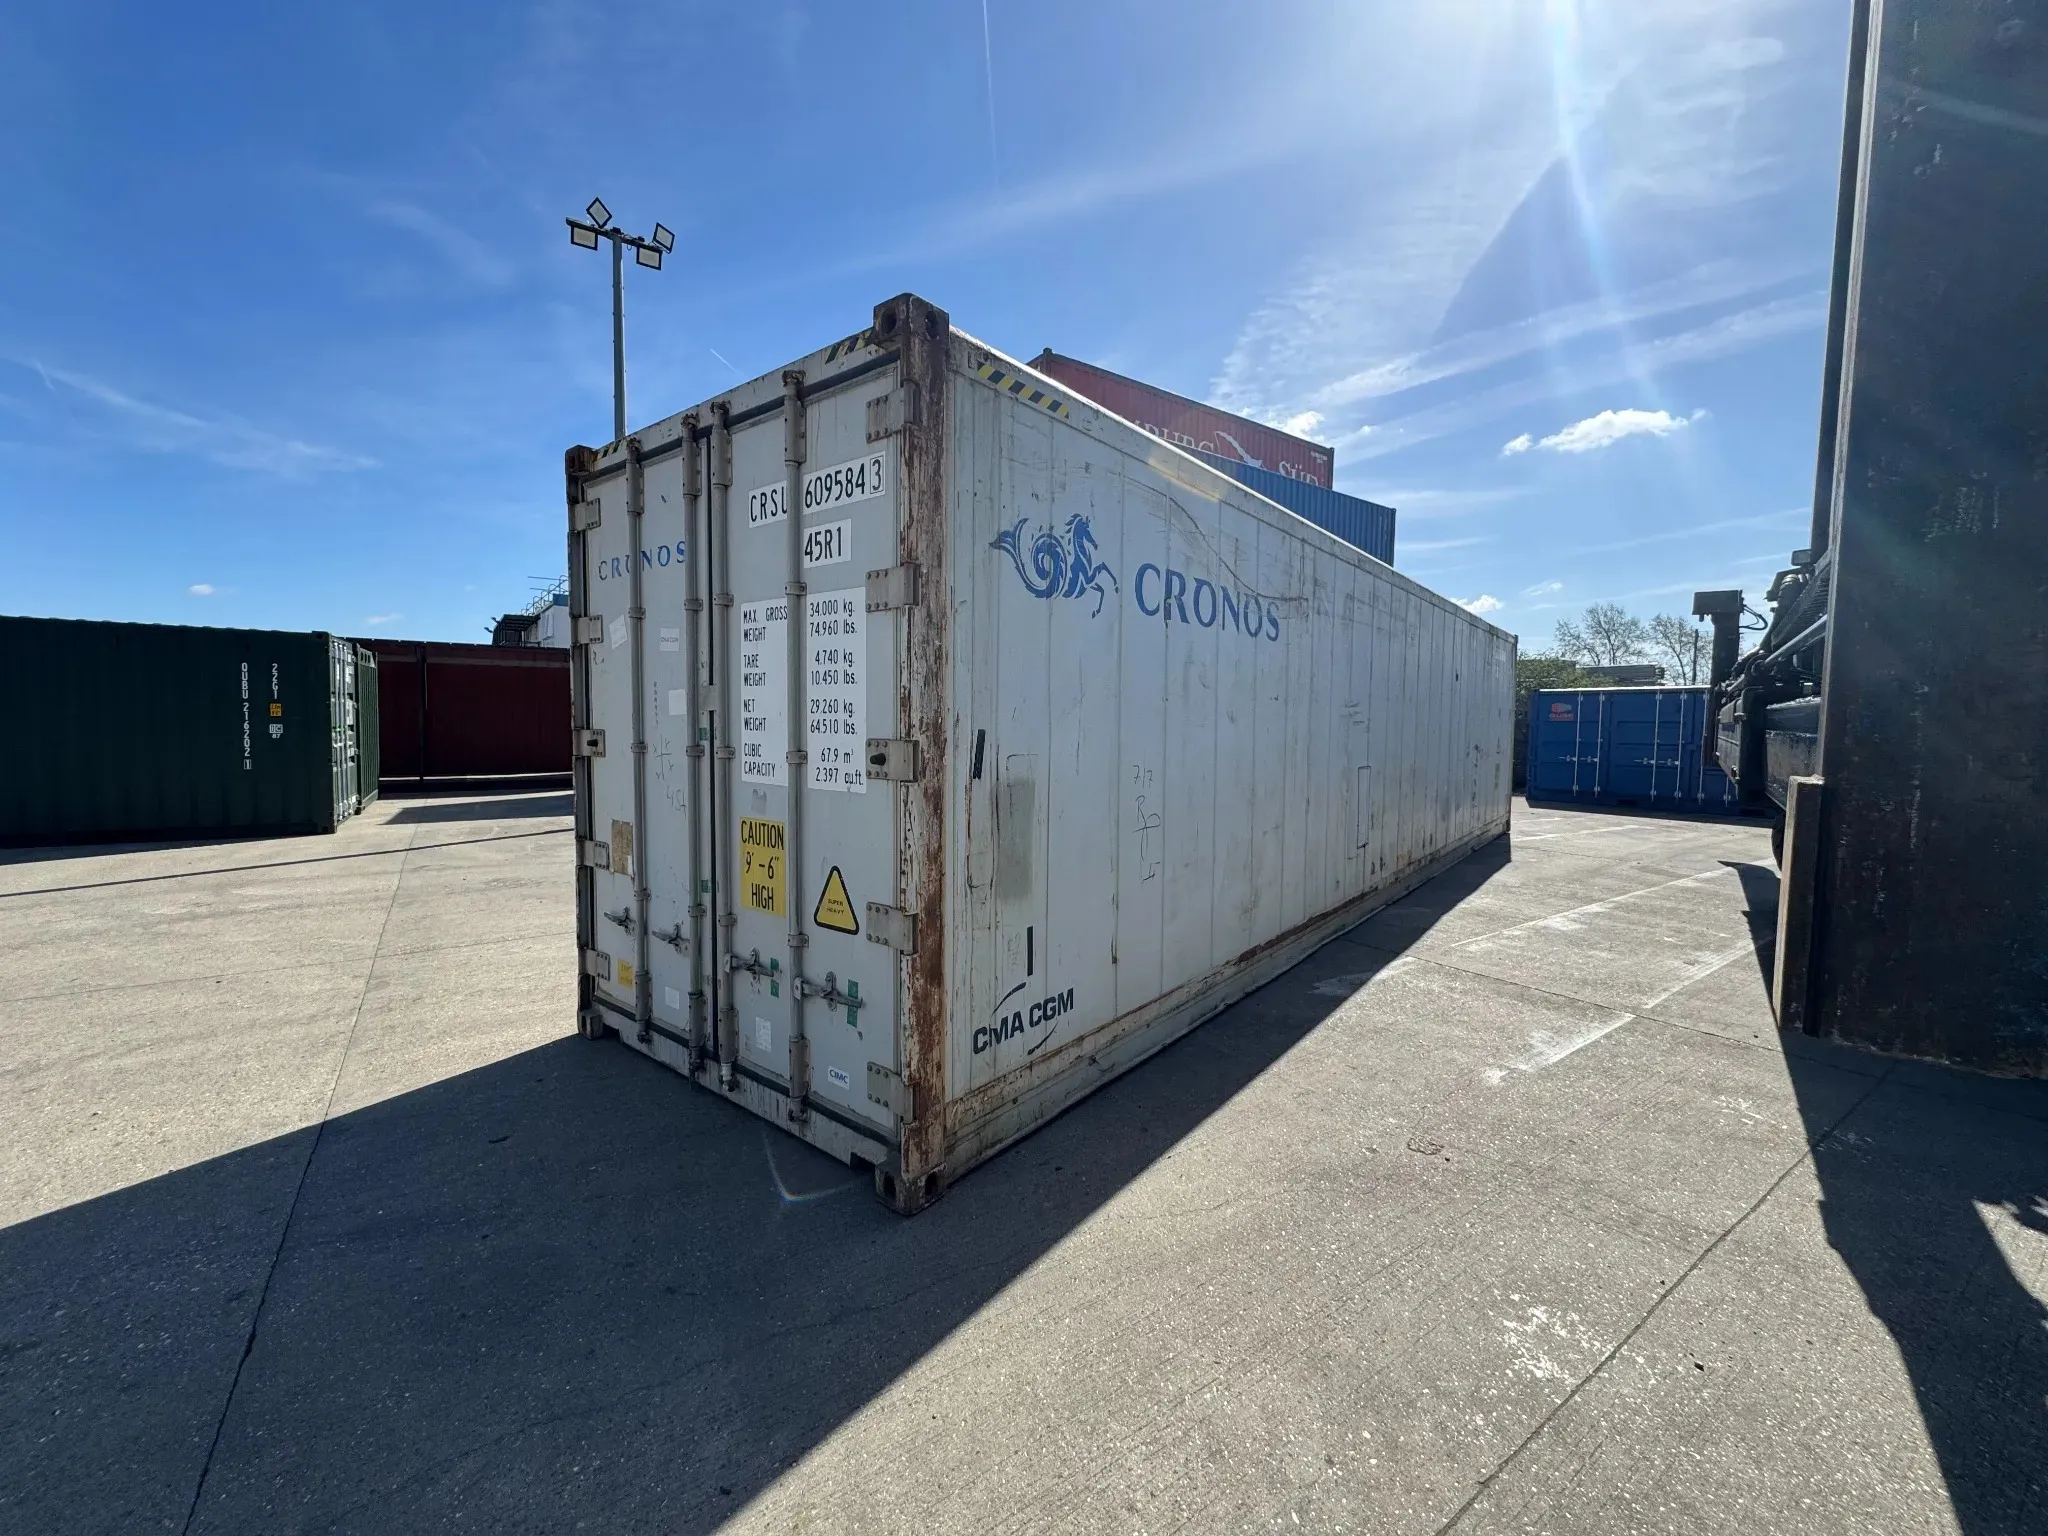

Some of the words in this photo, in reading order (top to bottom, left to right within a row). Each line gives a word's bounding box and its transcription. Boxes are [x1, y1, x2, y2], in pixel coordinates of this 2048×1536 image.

[804, 527, 842, 562] 45R1
[765, 605, 788, 622] GROSS
[809, 599, 838, 617] 34.000
[843, 598, 855, 617] kg.
[1135, 563, 1280, 642] CRONOS
[743, 626, 766, 642] WEIGHT
[809, 620, 839, 637] 74.960
[843, 619, 858, 635] lbs.
[743, 653, 760, 669] TARE
[815, 649, 839, 665] 4.740
[843, 649, 855, 667] kg.
[743, 672, 767, 687] WEIGHT
[811, 669, 839, 686] 10.450
[843, 669, 858, 685] lbs.
[743, 698, 756, 713] NET
[810, 698, 839, 715] 29.260
[843, 700, 855, 718] kg.
[743, 717, 767, 732] WEIGHT
[810, 719, 839, 734] 64.510
[843, 720, 858, 735] lbs.
[743, 743, 762, 758] CUBIC
[820, 748, 839, 763] 67.9
[743, 761, 776, 778] CAPACITY
[815, 767, 839, 784] 2.397
[740, 820, 784, 850] CAUTION
[751, 882, 774, 911] HIGH
[827, 898, 844, 907] SUPER
[972, 1010, 1025, 1055] CMA
[1029, 987, 1074, 1028] CGM
[829, 1069, 849, 1085] CIMC
